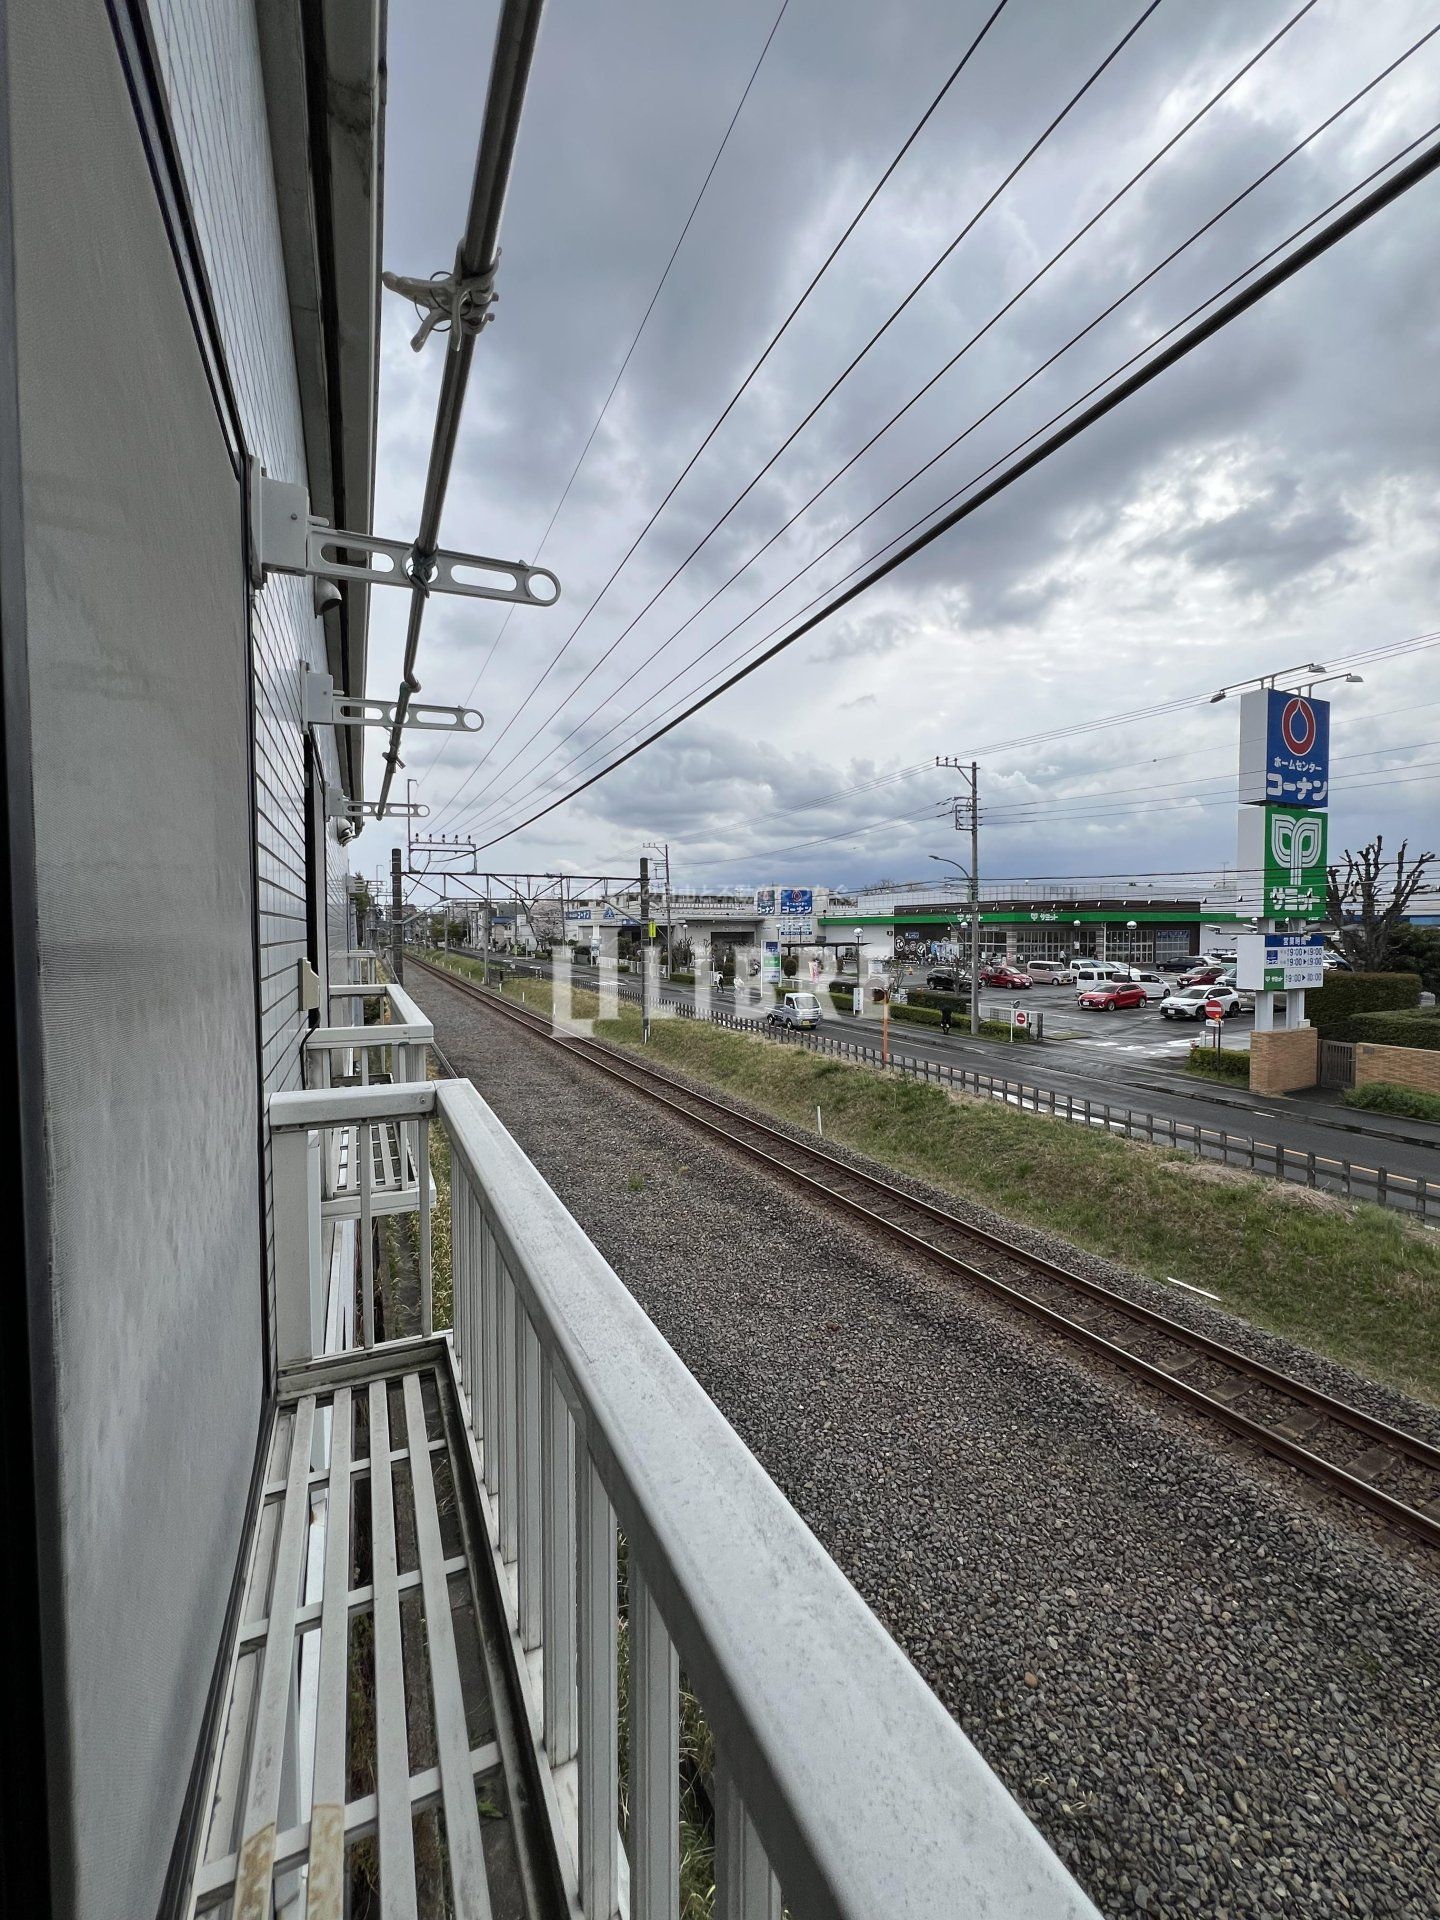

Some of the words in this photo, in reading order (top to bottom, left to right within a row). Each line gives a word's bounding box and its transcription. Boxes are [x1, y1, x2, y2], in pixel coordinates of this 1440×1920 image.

[1274, 756, 1322, 773] ホームセンター
[1266, 772, 1328, 800] コーナン
[1270, 886, 1320, 911] サミット
